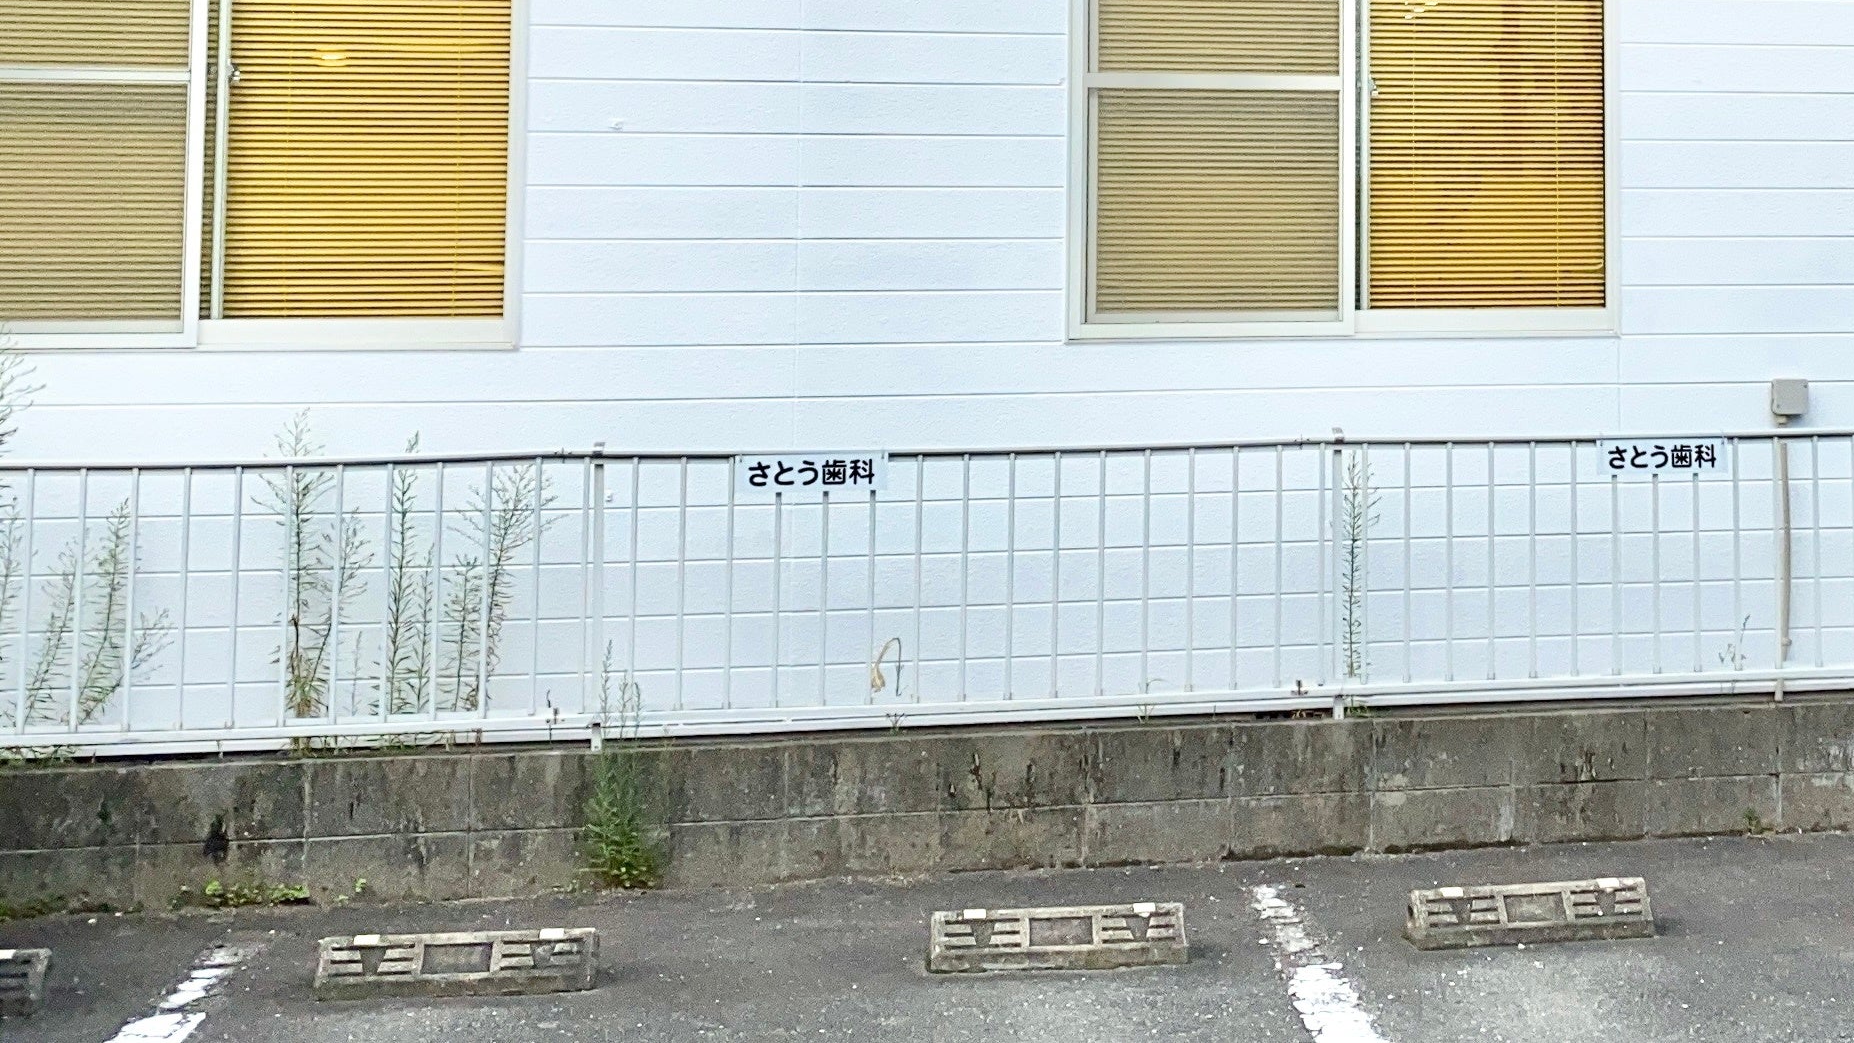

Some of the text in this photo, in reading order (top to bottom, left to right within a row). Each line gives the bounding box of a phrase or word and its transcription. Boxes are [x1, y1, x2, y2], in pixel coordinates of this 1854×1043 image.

[1608, 443, 1717, 470] さとう歯科
[748, 458, 875, 487] さとう歯科
